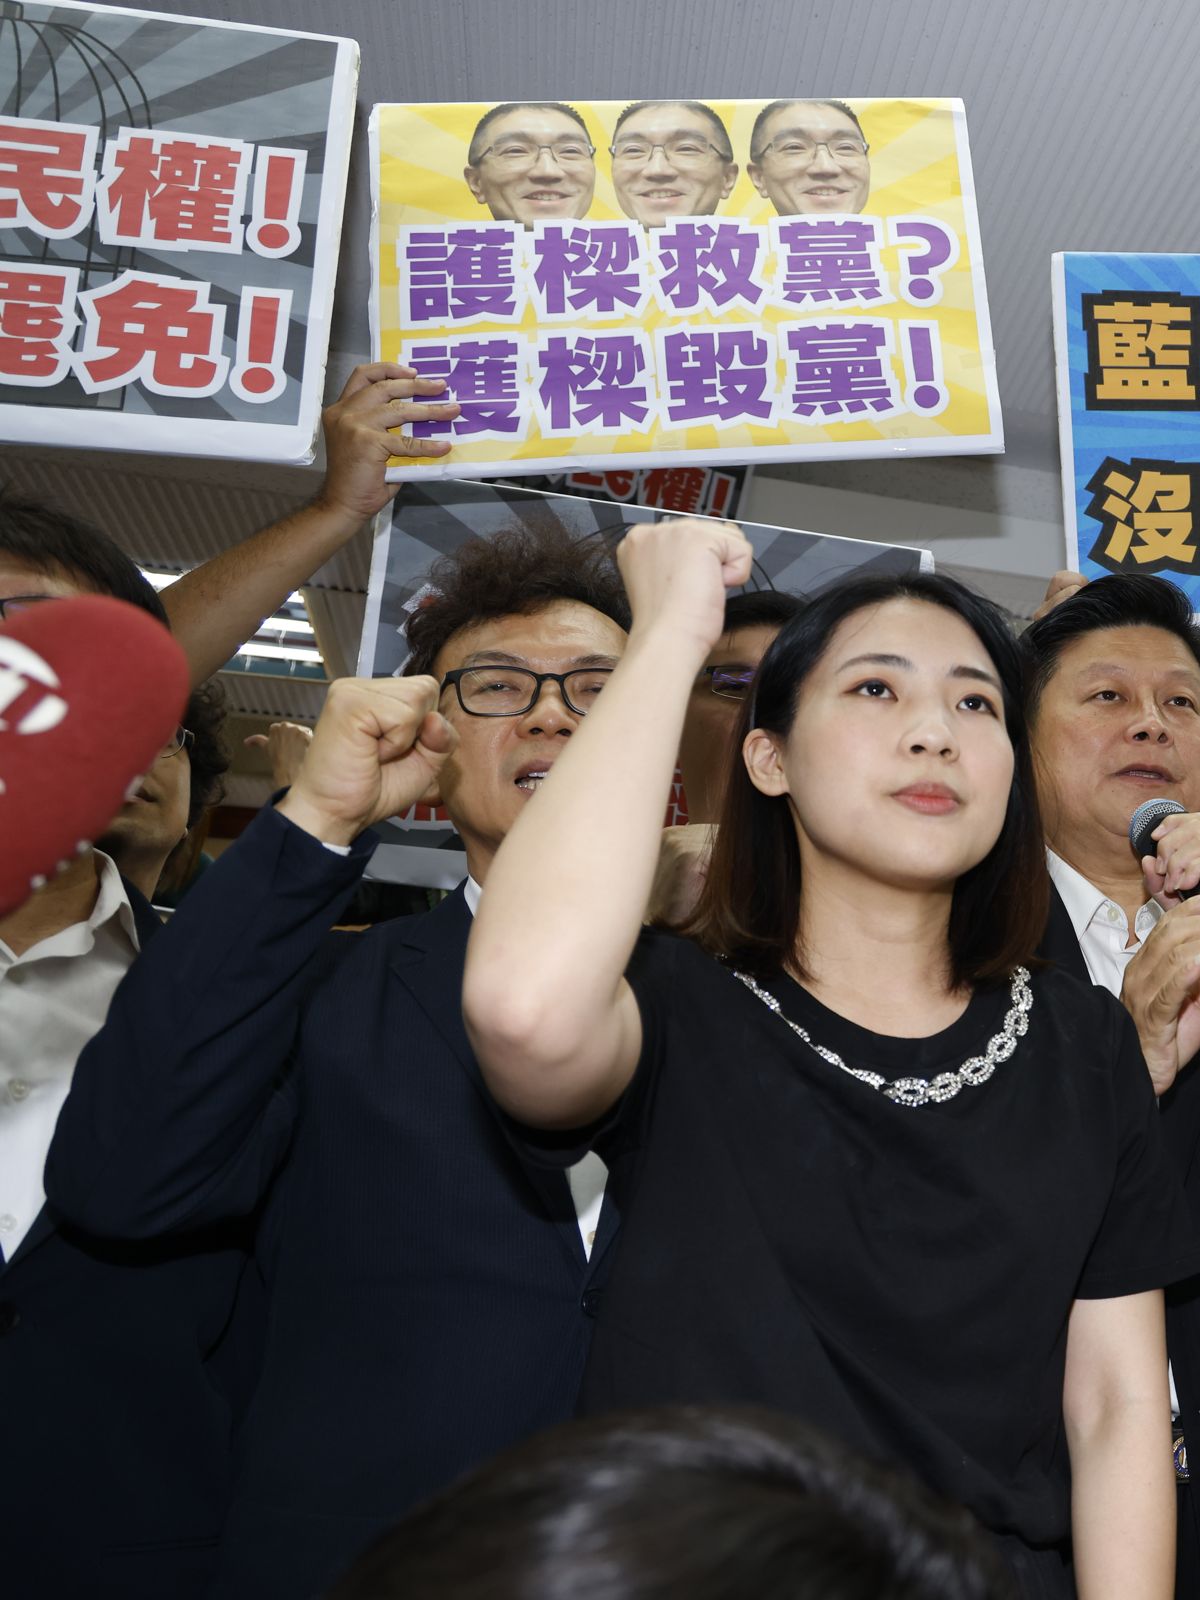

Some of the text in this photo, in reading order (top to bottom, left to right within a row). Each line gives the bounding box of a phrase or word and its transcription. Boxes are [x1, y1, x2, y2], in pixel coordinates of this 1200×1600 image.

[406, 220, 952, 322] 護樑救黨?
[410, 323, 942, 439] 護樑毀黨!
